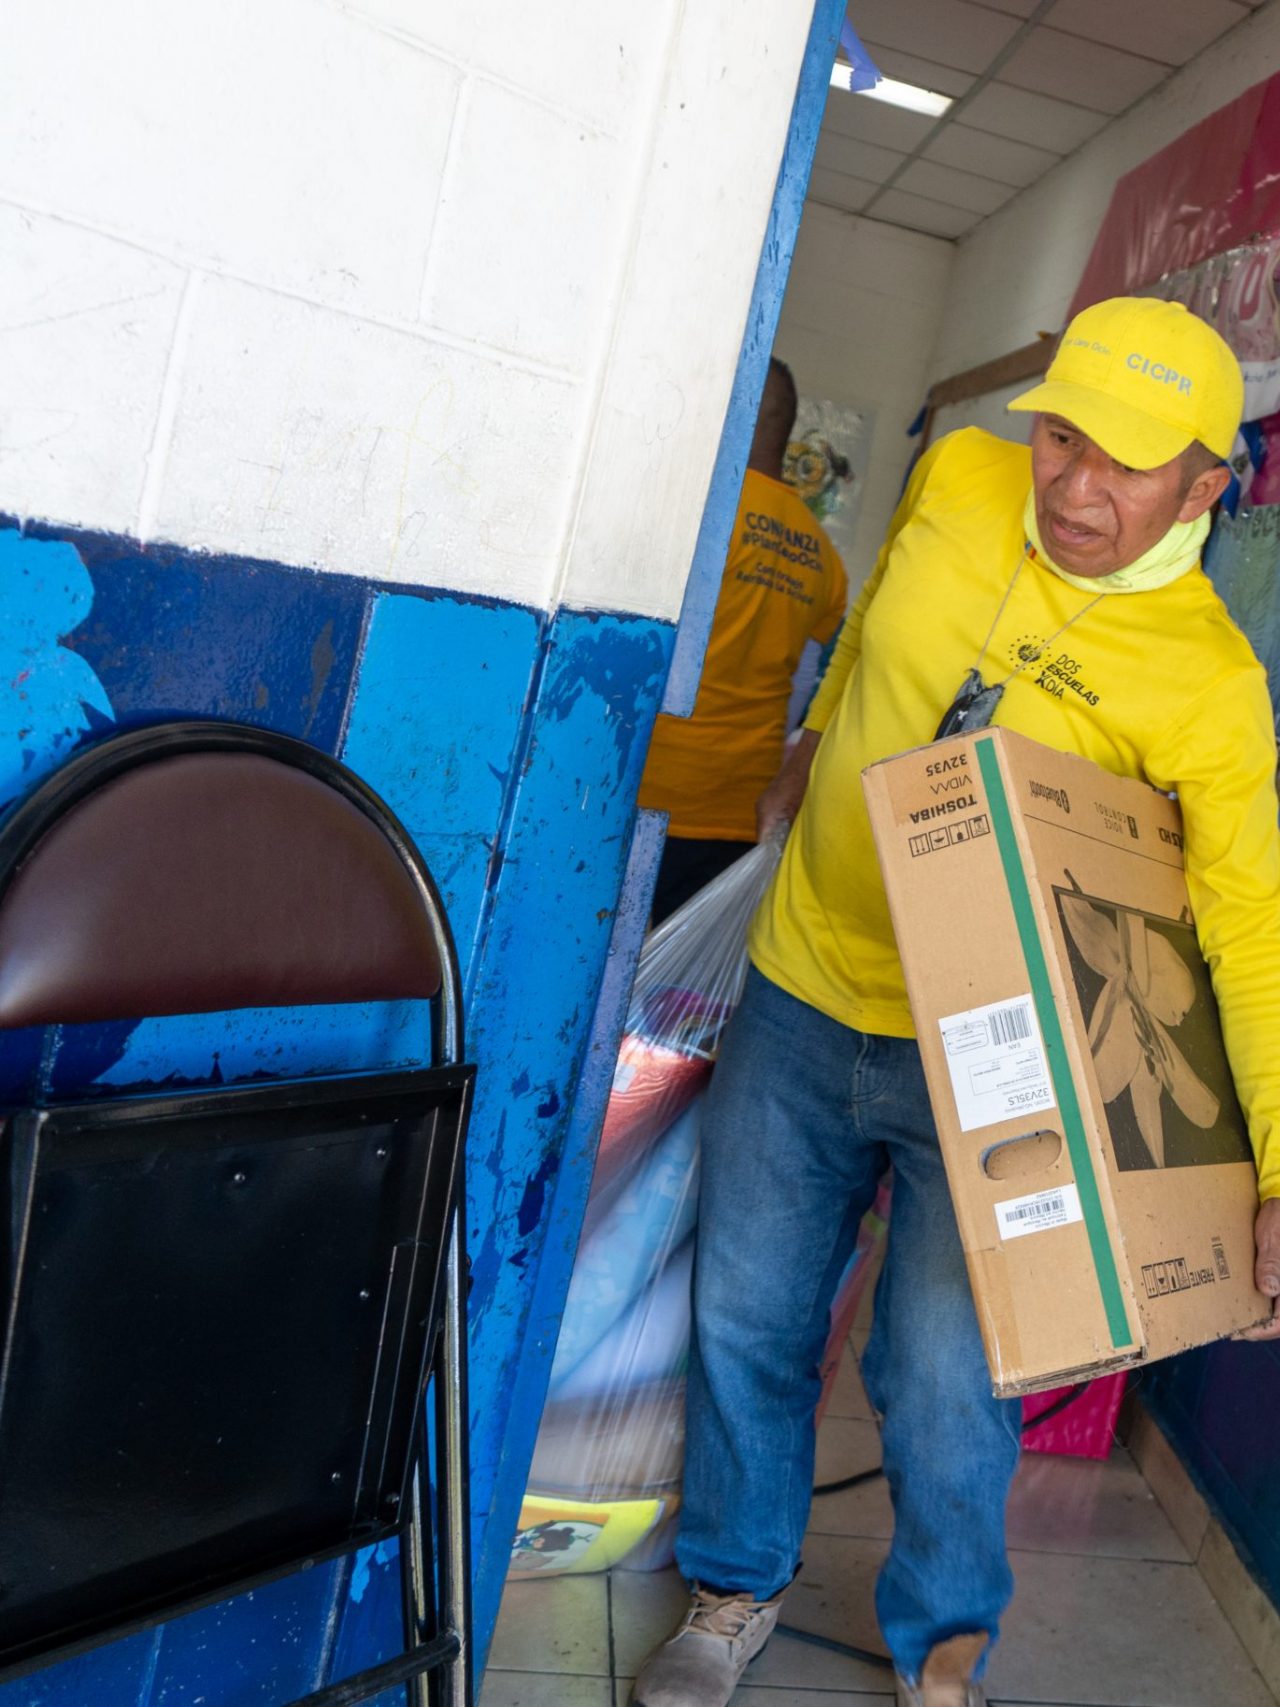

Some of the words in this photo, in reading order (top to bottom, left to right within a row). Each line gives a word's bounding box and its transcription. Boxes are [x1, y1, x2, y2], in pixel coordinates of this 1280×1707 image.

[1127, 353, 1192, 396] CICPR
[1056, 654, 1082, 675] DOS
[1046, 664, 1100, 706] ESCUELAS
[926, 754, 967, 777] 32V35
[910, 794, 978, 824] TOSHIBA
[1008, 1087, 1049, 1106] 32V35LS
